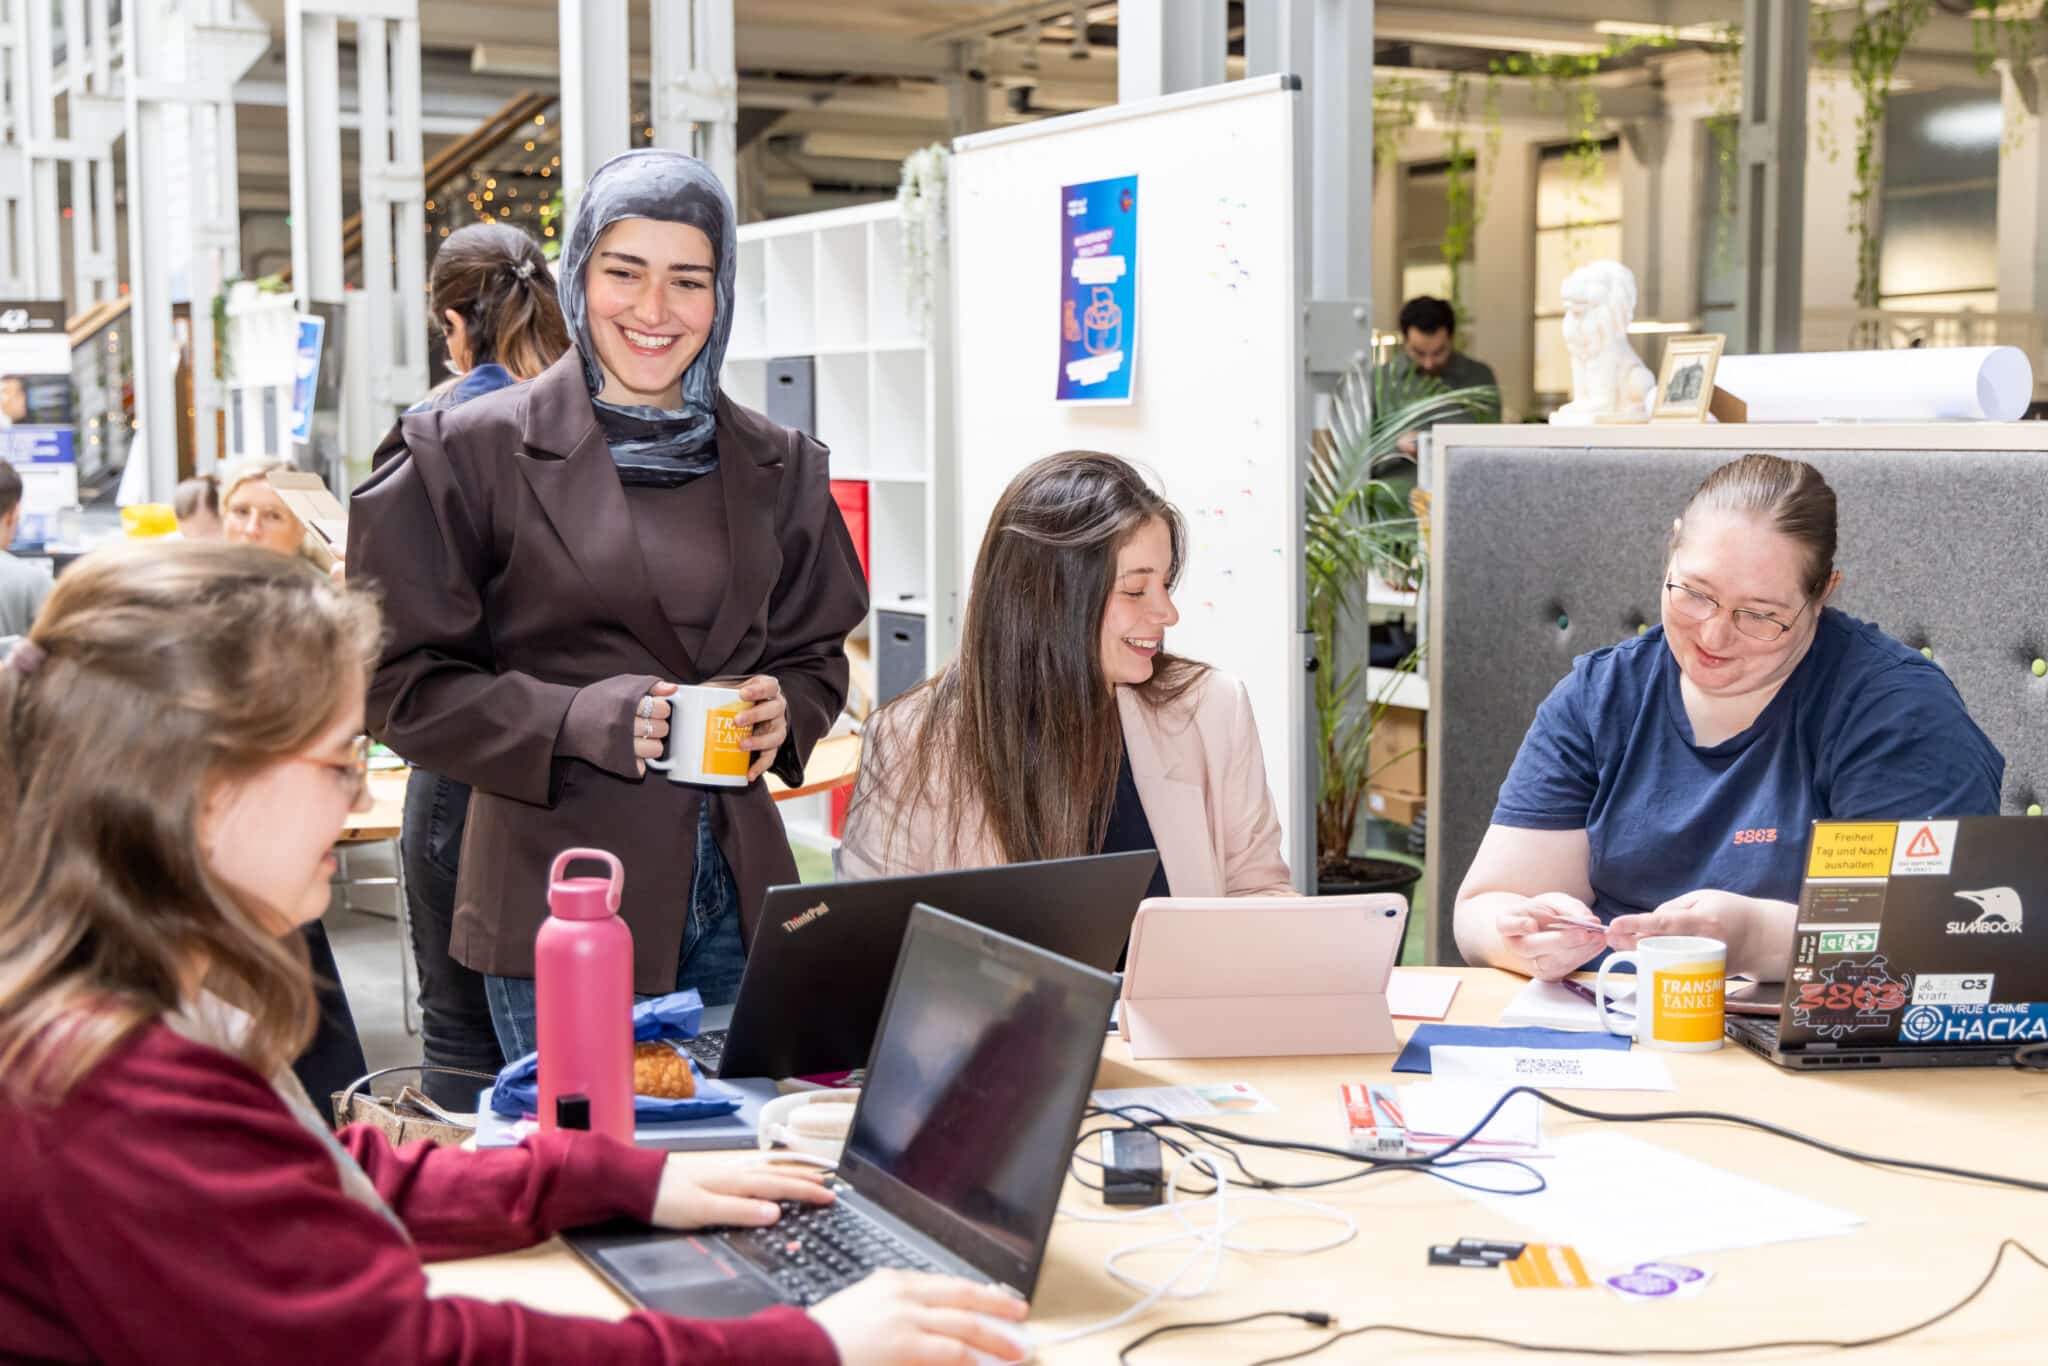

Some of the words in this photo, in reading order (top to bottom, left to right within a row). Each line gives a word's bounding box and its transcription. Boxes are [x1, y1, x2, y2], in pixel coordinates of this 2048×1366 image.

[1834, 832, 1874, 842] Freiheit
[1816, 846, 1833, 857] Tag
[1837, 846, 1855, 856] und
[1859, 845, 1888, 856] Nacht
[1824, 860, 1874, 870] aushalten
[782, 902, 829, 932] ThinkPad
[1961, 979, 1988, 990] C3
[1662, 994, 1714, 1009] TANKE
[1951, 1004, 1984, 1015] TRUE
[1987, 1003, 2031, 1014] CRIME
[1944, 1017, 2048, 1041] HACKA
